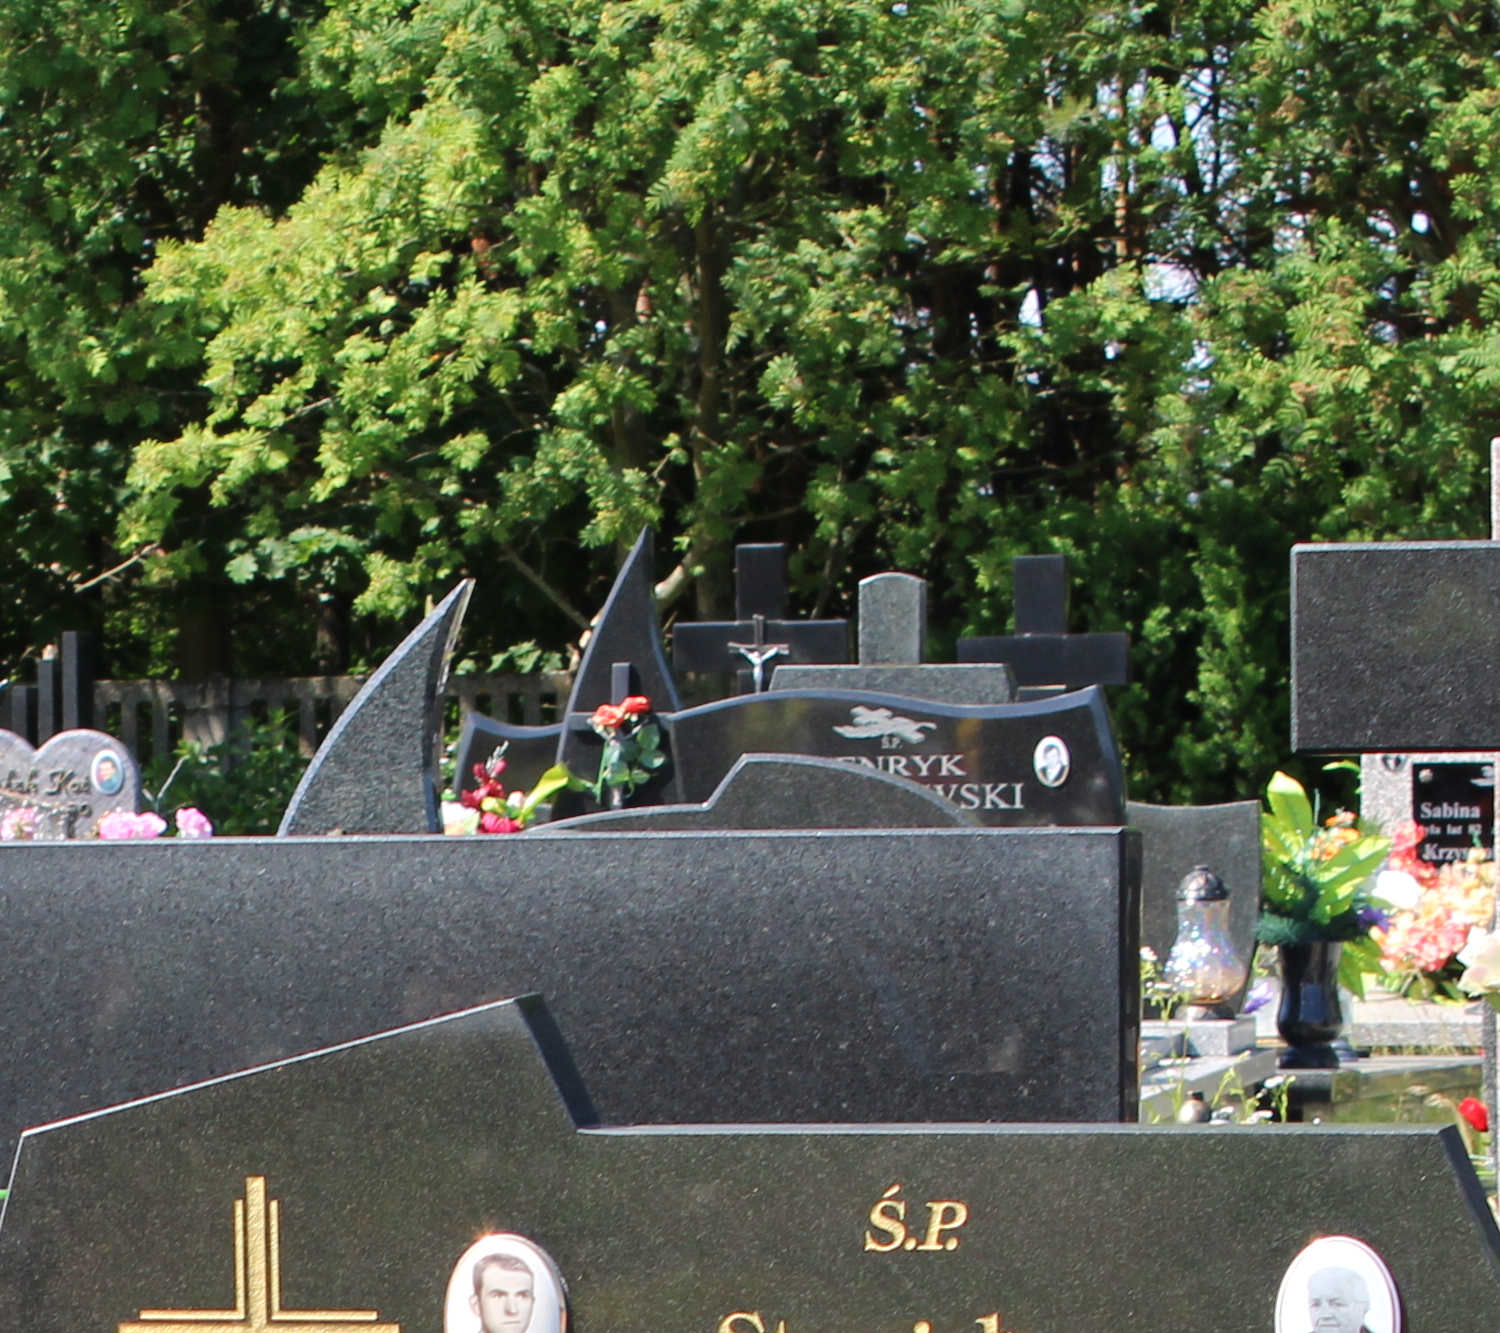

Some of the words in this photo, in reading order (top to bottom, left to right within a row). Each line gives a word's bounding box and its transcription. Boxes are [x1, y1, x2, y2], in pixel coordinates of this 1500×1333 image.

[842, 754, 967, 776] NRYK
[1420, 802, 1481, 819] Sabina
[1446, 824, 1463, 835] lat
[863, 1185, 968, 1253] Ś.P.
